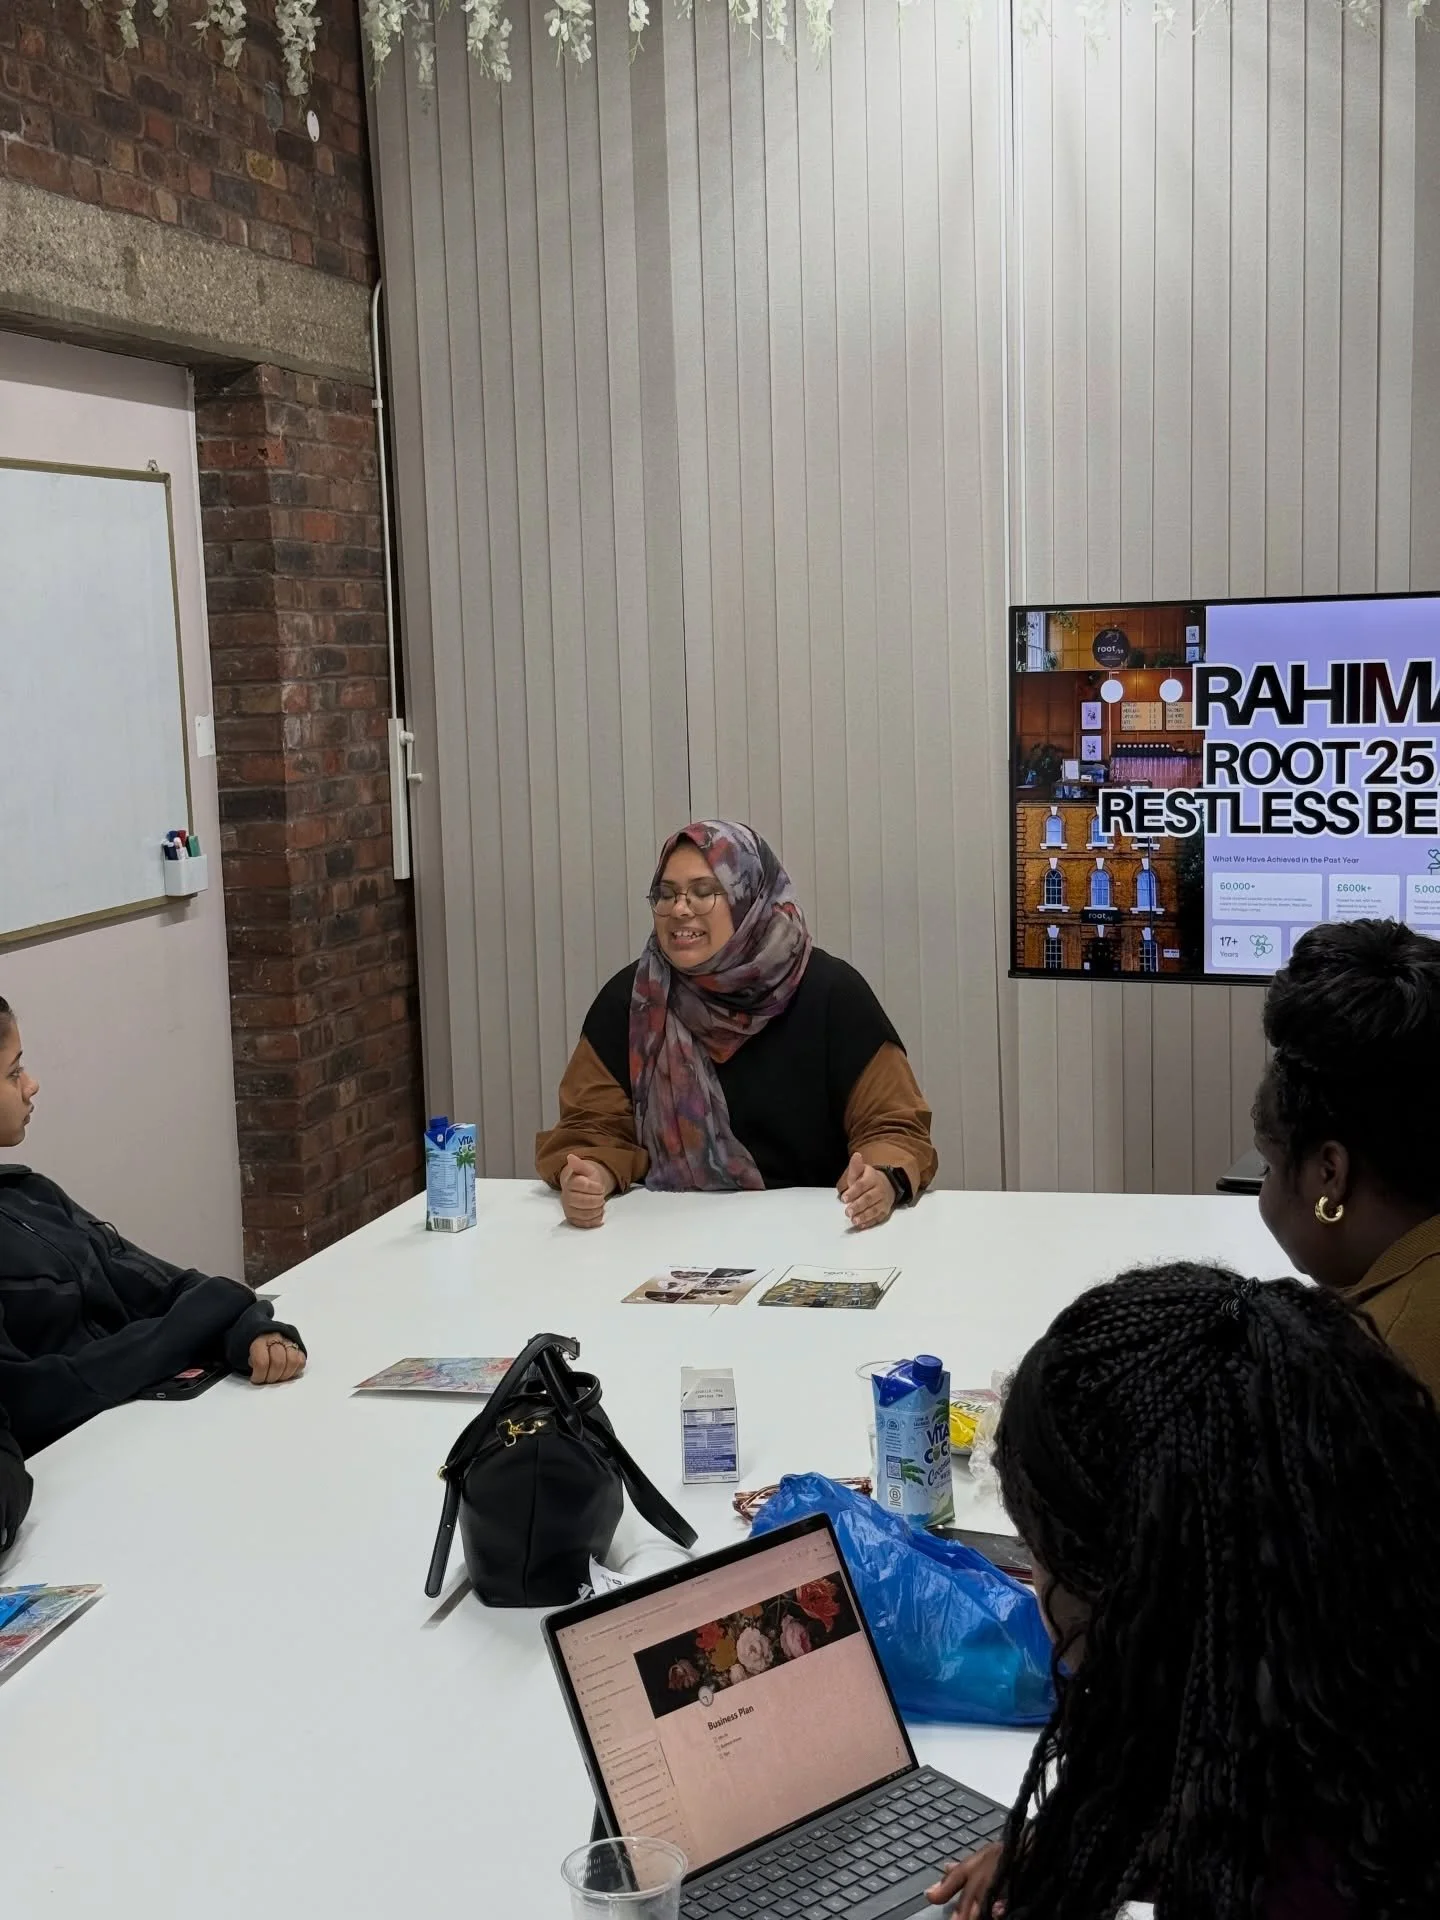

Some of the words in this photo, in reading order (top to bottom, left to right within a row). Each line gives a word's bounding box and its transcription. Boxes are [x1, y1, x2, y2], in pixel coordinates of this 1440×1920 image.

[1195, 660, 1440, 727] RAHIM
[1205, 740, 1361, 786] ROOT
[1363, 739, 1435, 786] 25
[1101, 790, 1361, 836] RESTLESS
[1212, 855, 1232, 863] What
[1233, 855, 1245, 863] We
[1246, 855, 1266, 863] Have
[1267, 856, 1301, 864] Achieved
[1301, 856, 1309, 864] in
[1310, 856, 1322, 864] the
[1323, 856, 1341, 864] Past
[1342, 856, 1360, 864] Year
[1337, 883, 1372, 893] £600k+
[1219, 936, 1239, 948] 17+
[1219, 951, 1239, 959] Years
[458, 1135, 474, 1146] VITA
[926, 1423, 950, 1447] VITA
[707, 1712, 739, 1731] Business
[737, 1705, 755, 1717] Plan
